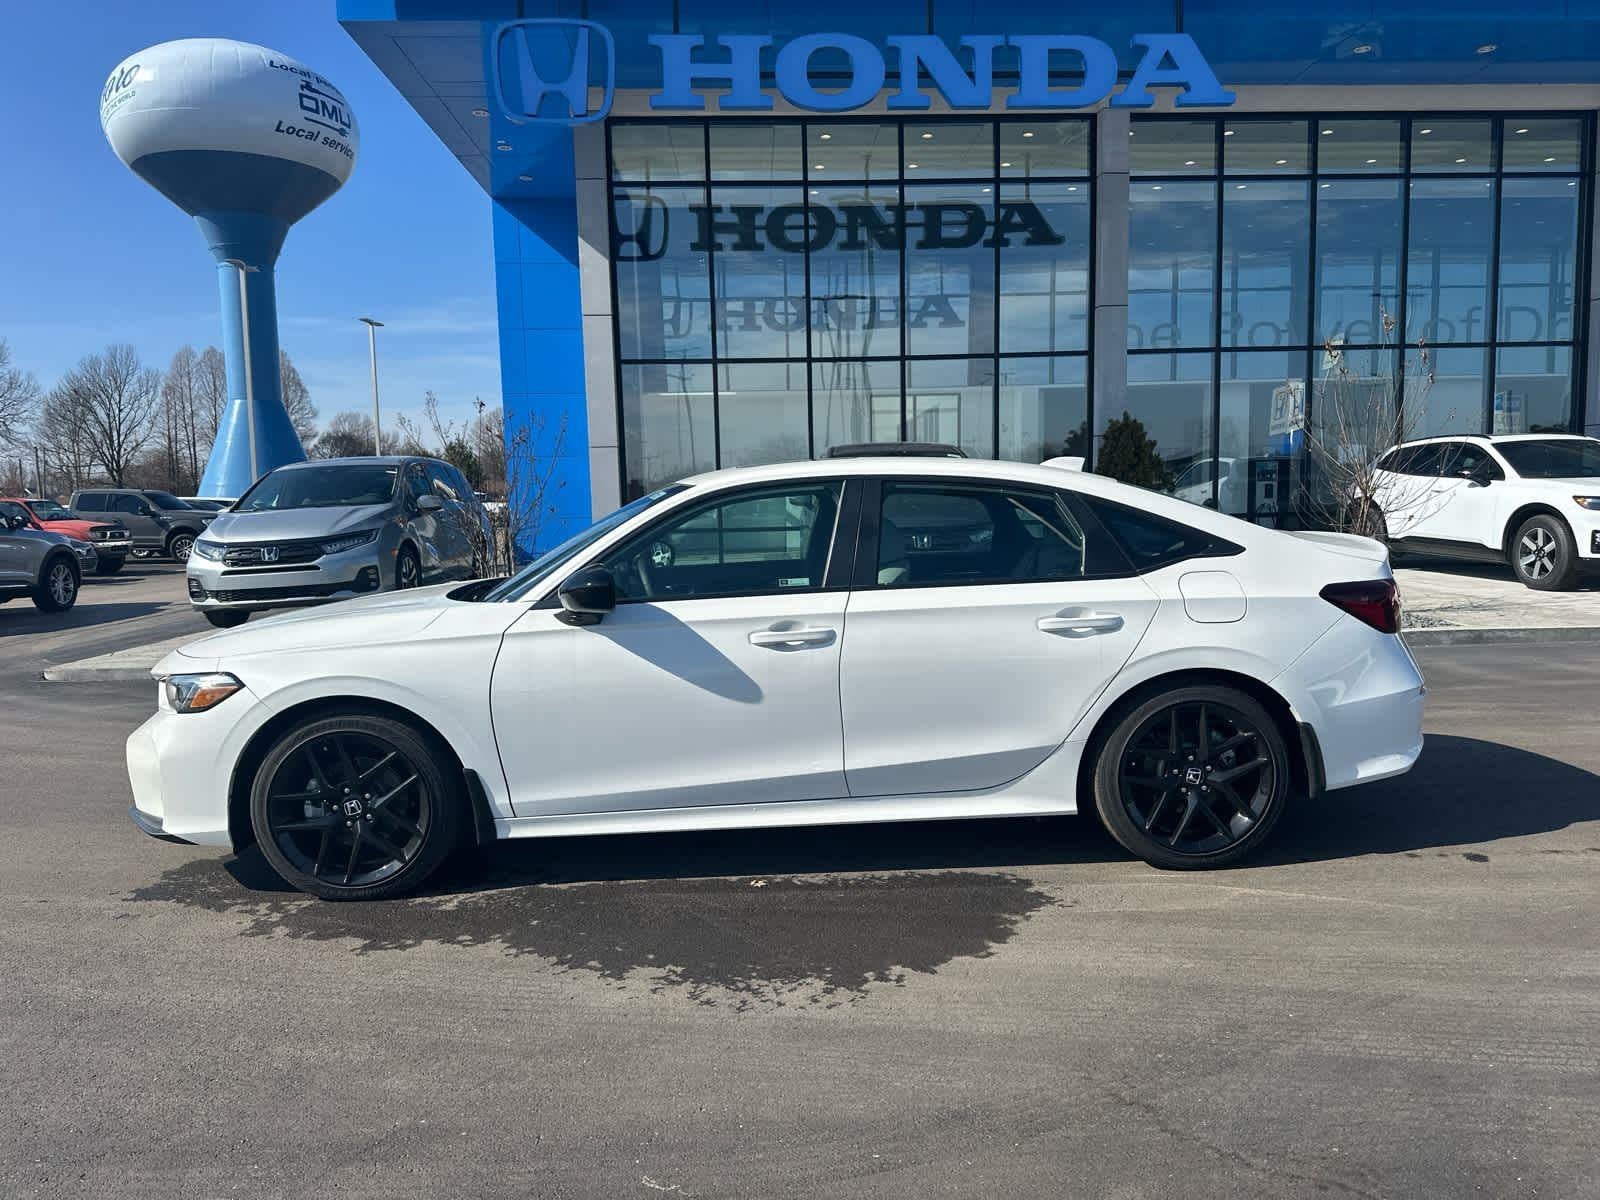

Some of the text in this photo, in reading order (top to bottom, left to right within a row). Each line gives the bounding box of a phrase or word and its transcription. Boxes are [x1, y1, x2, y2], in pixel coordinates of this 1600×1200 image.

[269, 60, 311, 78] Local
[648, 33, 1236, 112] HONDA
[298, 92, 351, 130] OMU
[275, 120, 320, 141] Local
[688, 201, 1066, 252] HONDA
